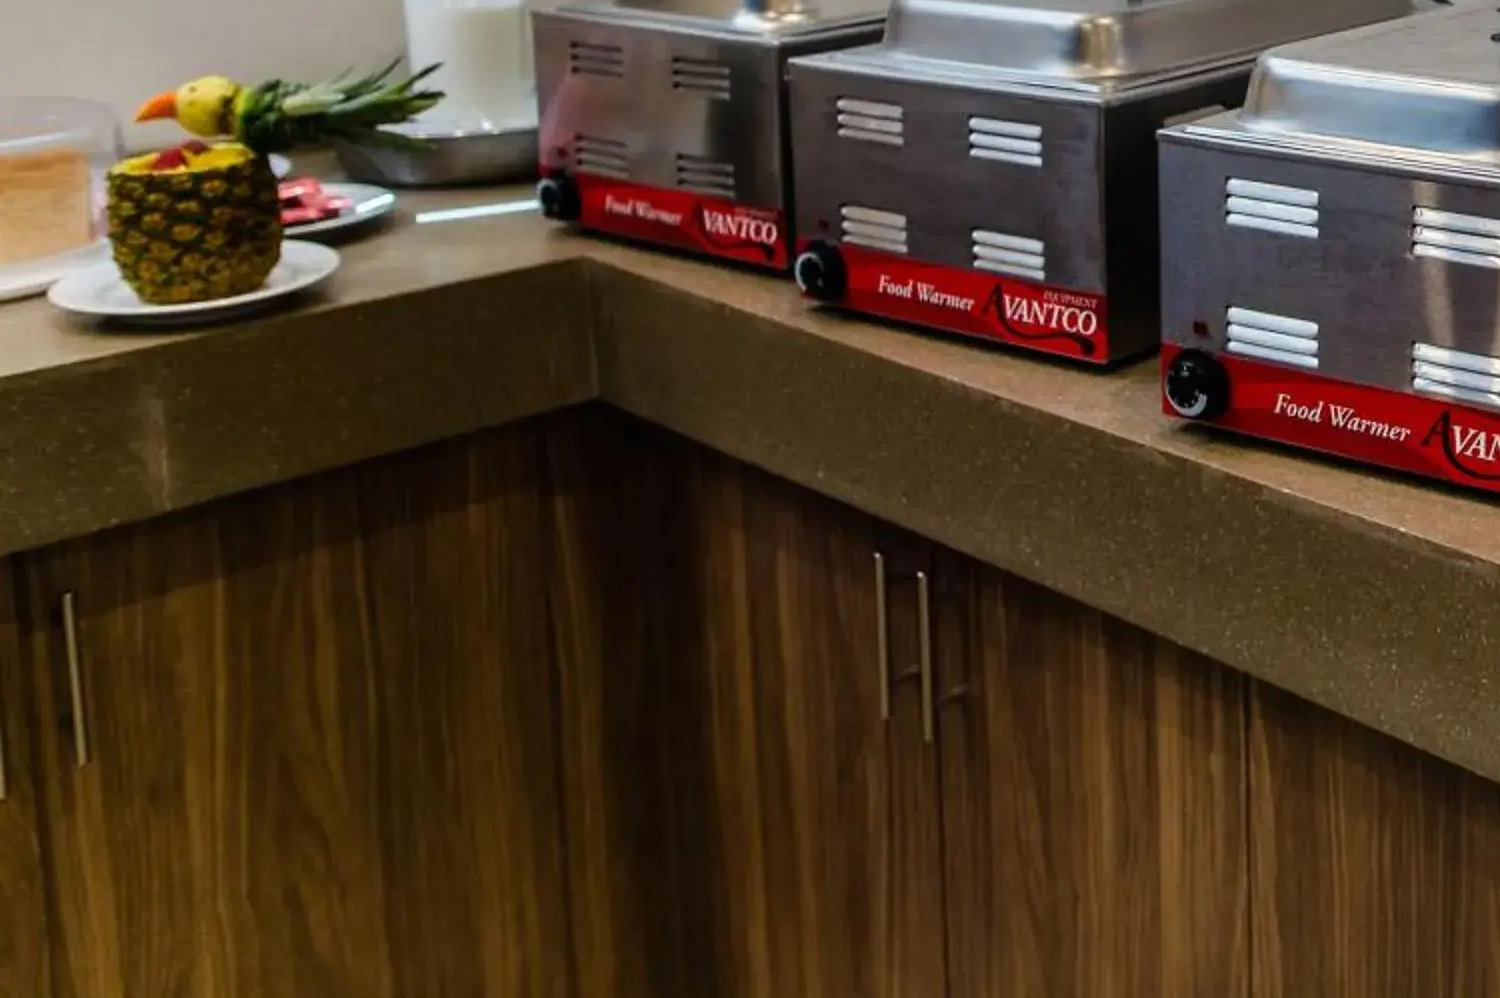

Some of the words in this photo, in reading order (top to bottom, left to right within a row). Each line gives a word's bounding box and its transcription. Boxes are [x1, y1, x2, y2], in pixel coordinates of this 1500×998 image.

[878, 274, 914, 300] Food
[916, 282, 975, 312] Warmer
[980, 282, 1097, 335] AVANTCO
[1273, 393, 1322, 424] Food
[1329, 404, 1411, 443] Warmer
